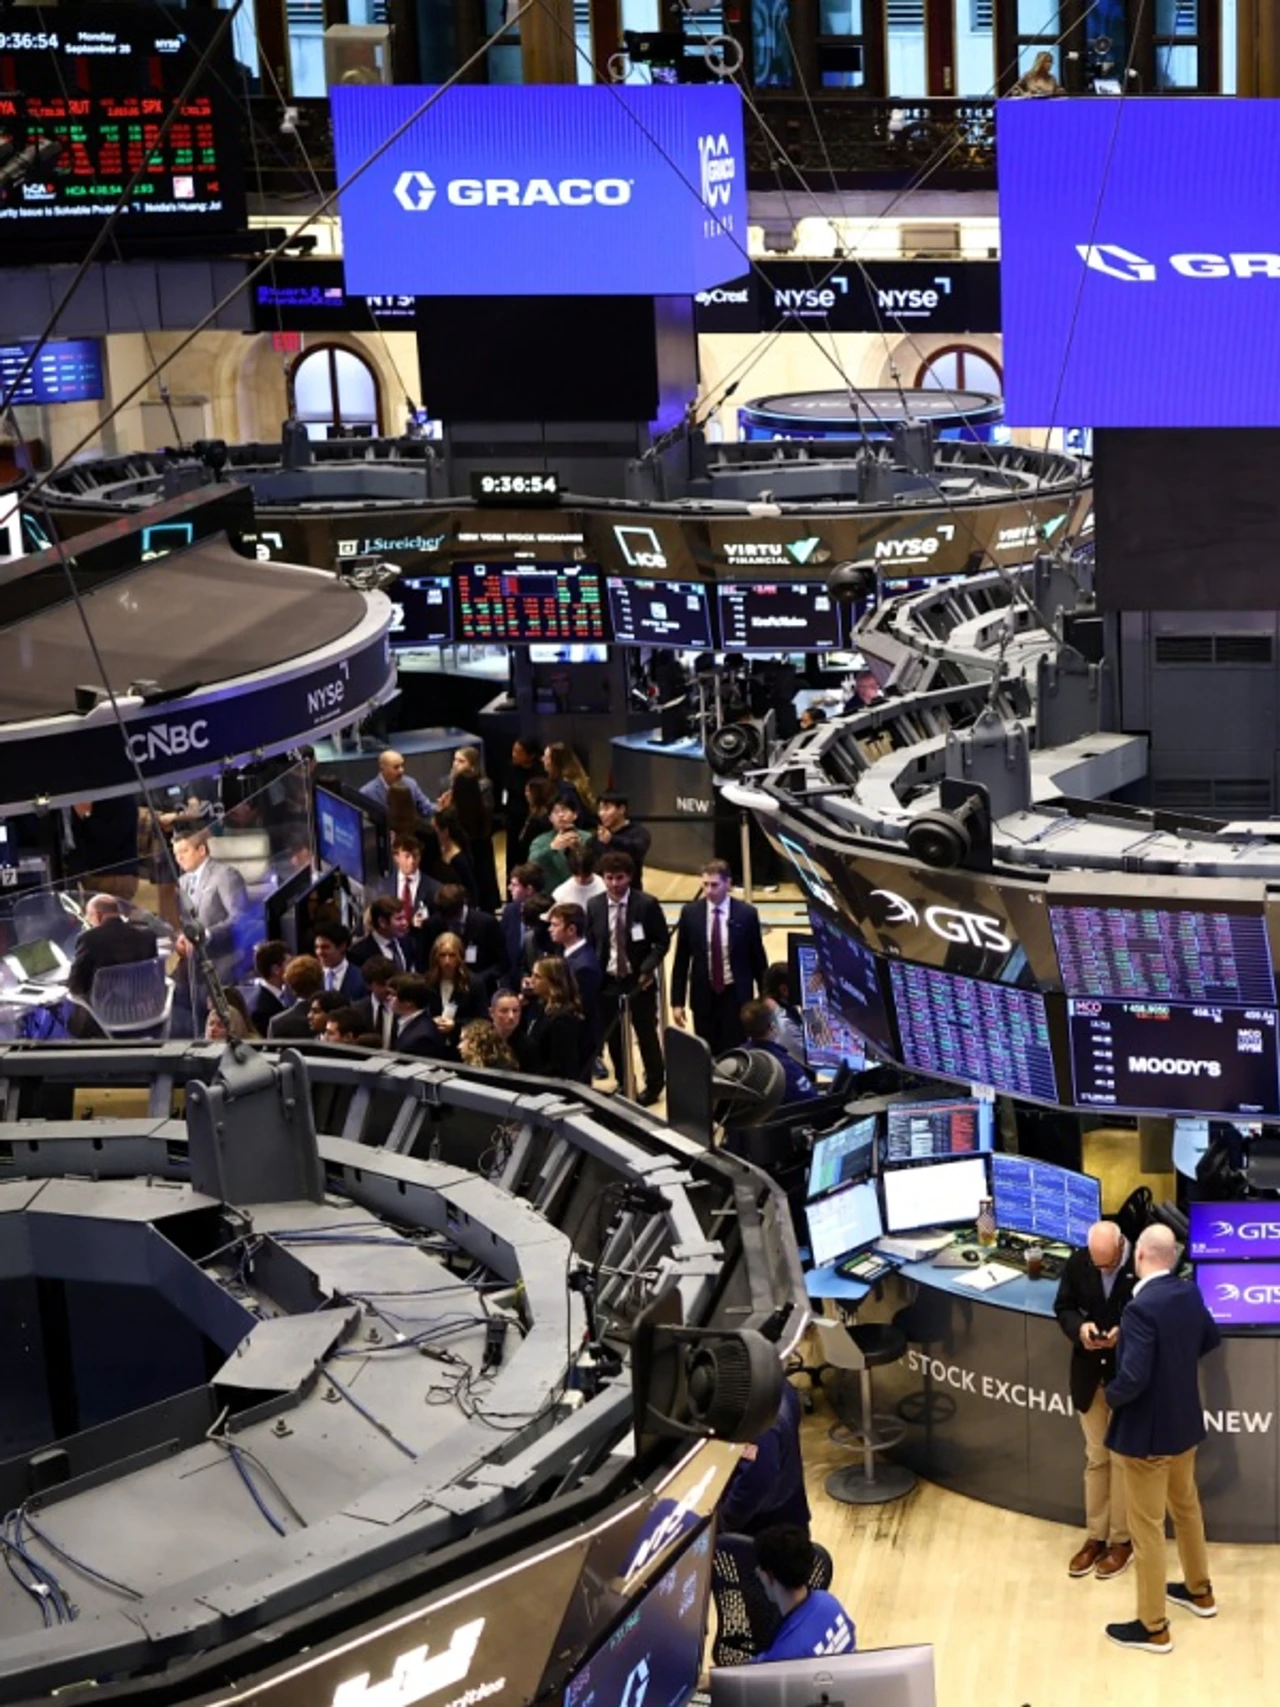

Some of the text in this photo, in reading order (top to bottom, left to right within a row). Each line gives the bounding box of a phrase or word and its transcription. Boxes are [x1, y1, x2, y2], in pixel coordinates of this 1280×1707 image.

[78, 32, 116, 43] Monday
[447, 178, 632, 206] GRACO
[481, 475, 556, 493] 9:36:54
[724, 544, 782, 557] VIRTU
[728, 556, 790, 565] FINANCIAL
[126, 719, 210, 764] CNBC
[676, 797, 709, 812] NEW
[924, 906, 1012, 953] GTS
[1128, 1056, 1222, 1077] MOODY'S
[908, 1350, 1074, 1417] STOCK EXCHA
[1202, 1410, 1273, 1434] NEW
